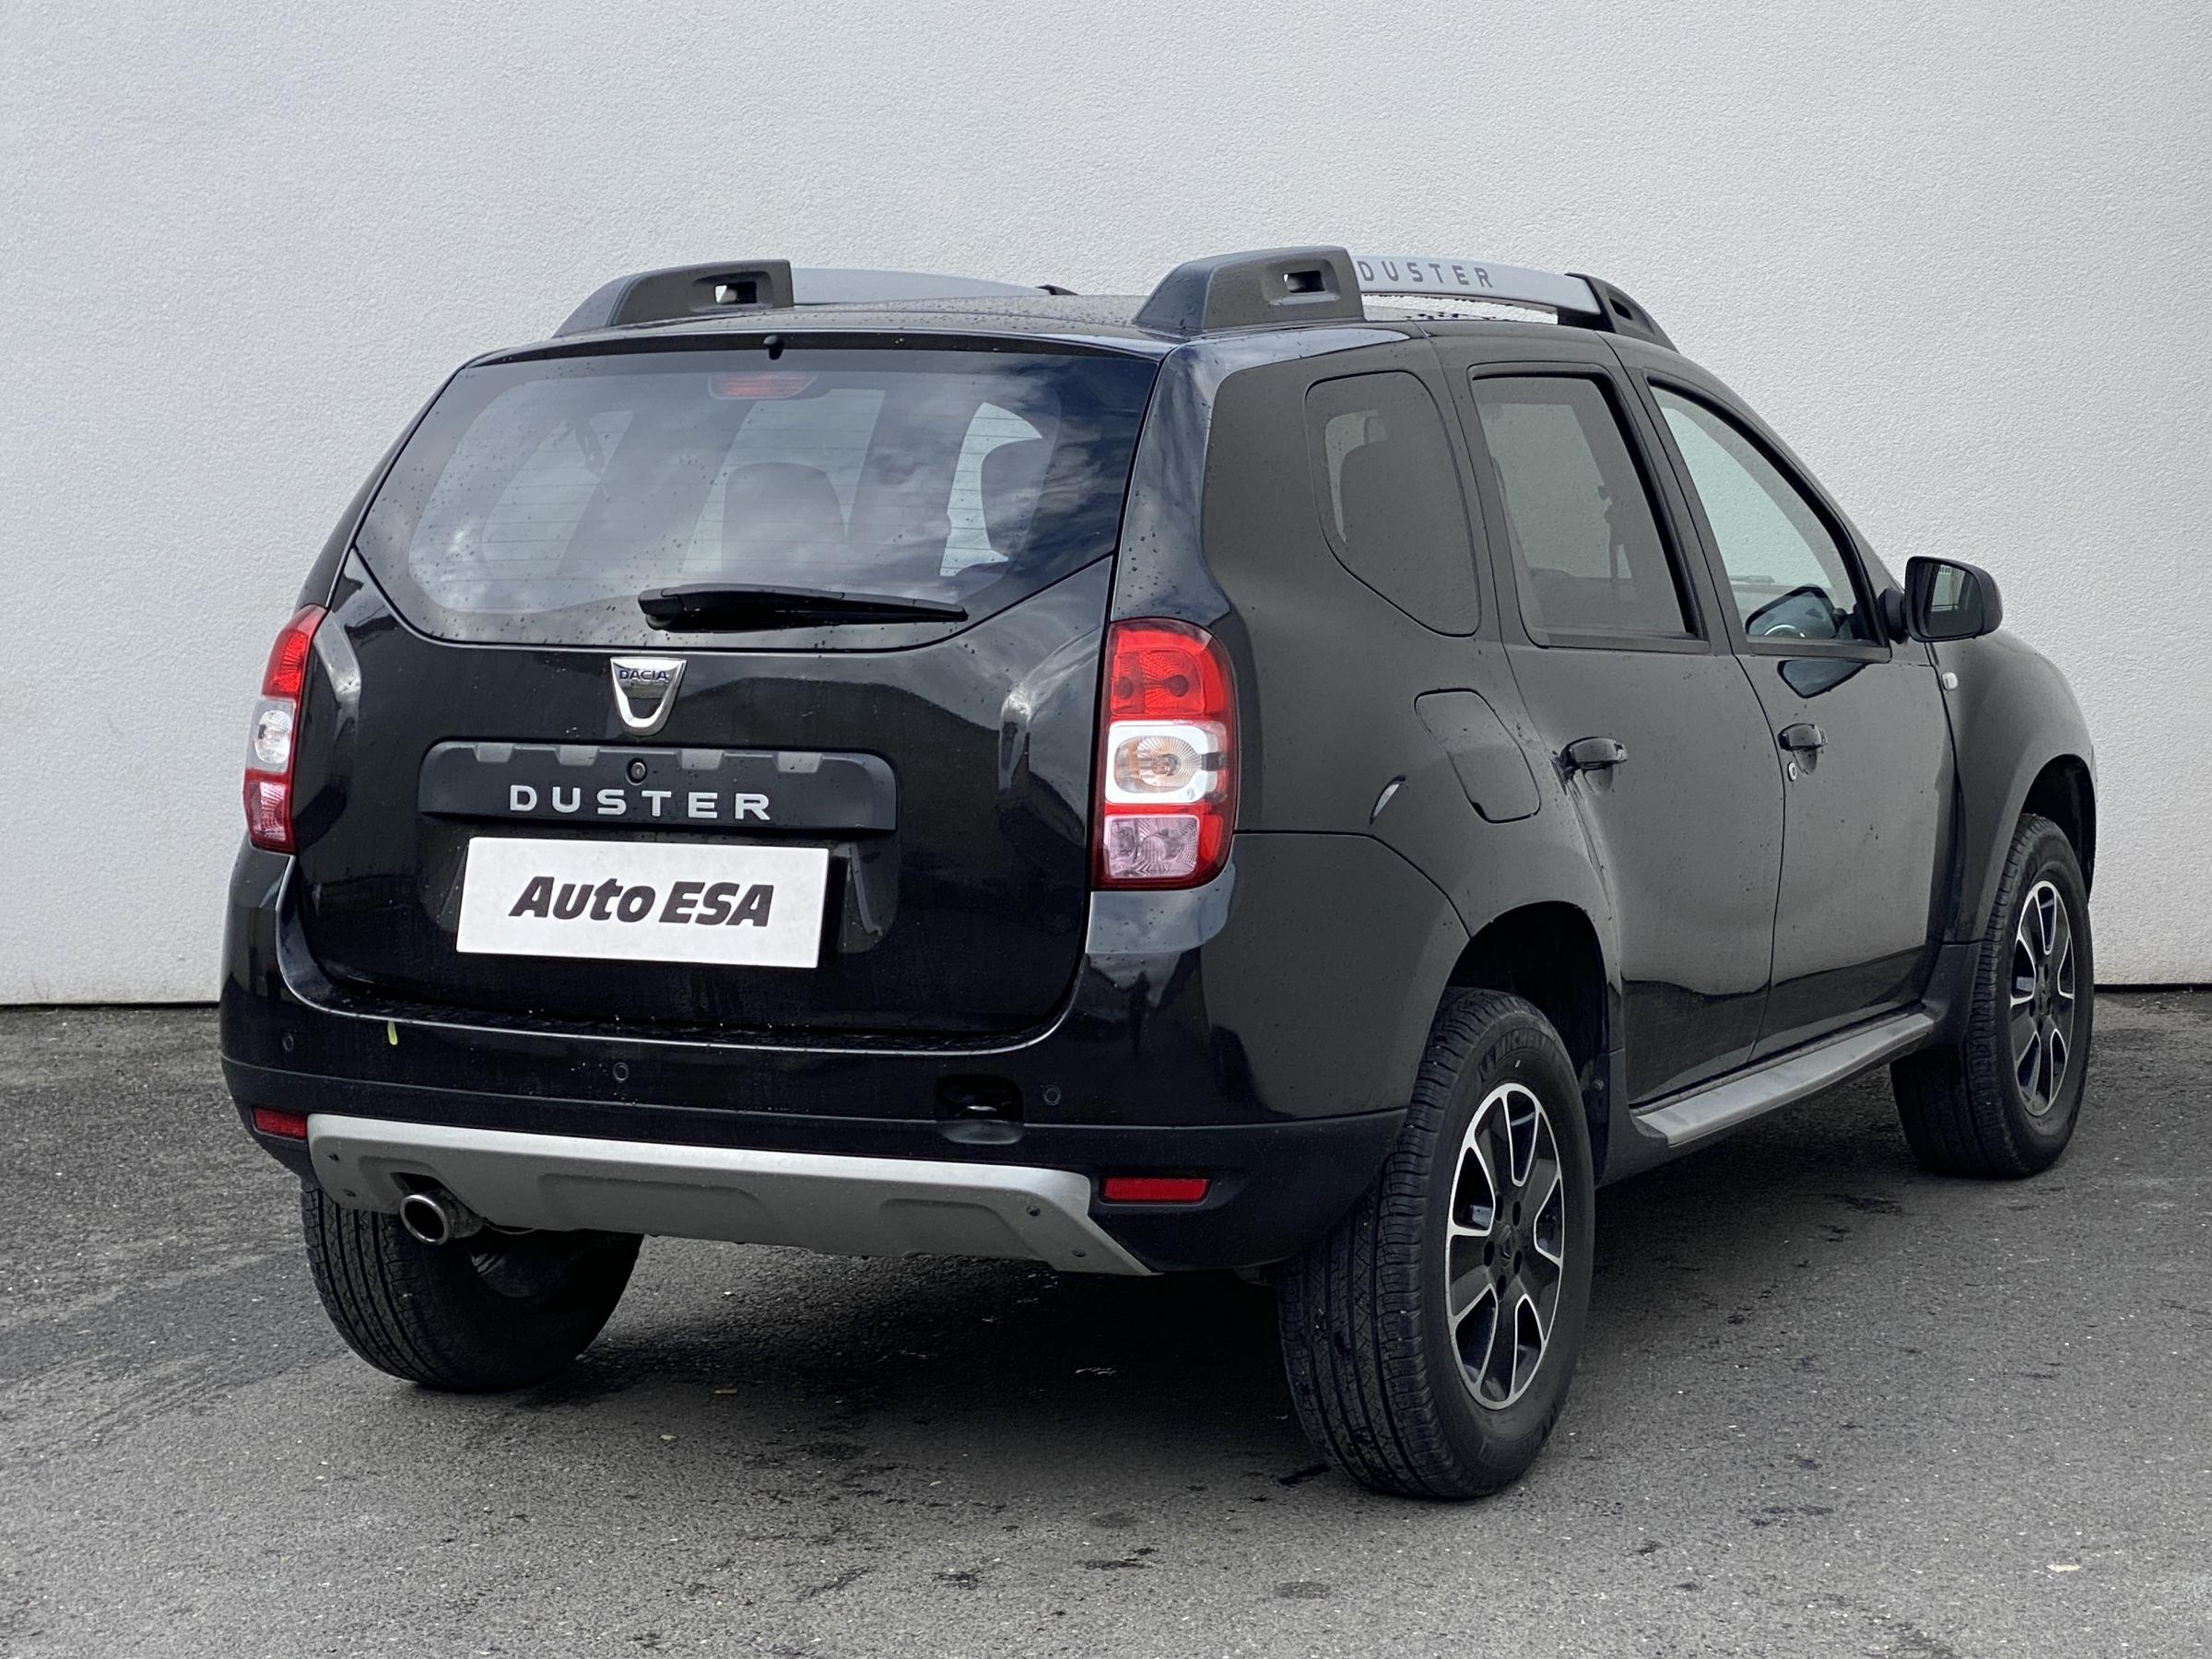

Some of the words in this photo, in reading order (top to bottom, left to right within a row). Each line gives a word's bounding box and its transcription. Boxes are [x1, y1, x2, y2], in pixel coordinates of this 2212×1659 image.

[1357, 260, 1493, 288] DUSTER
[618, 669, 668, 680] DACIA
[510, 784, 771, 820] DUSTER
[509, 876, 656, 923] Auto
[658, 881, 774, 927] ESA
